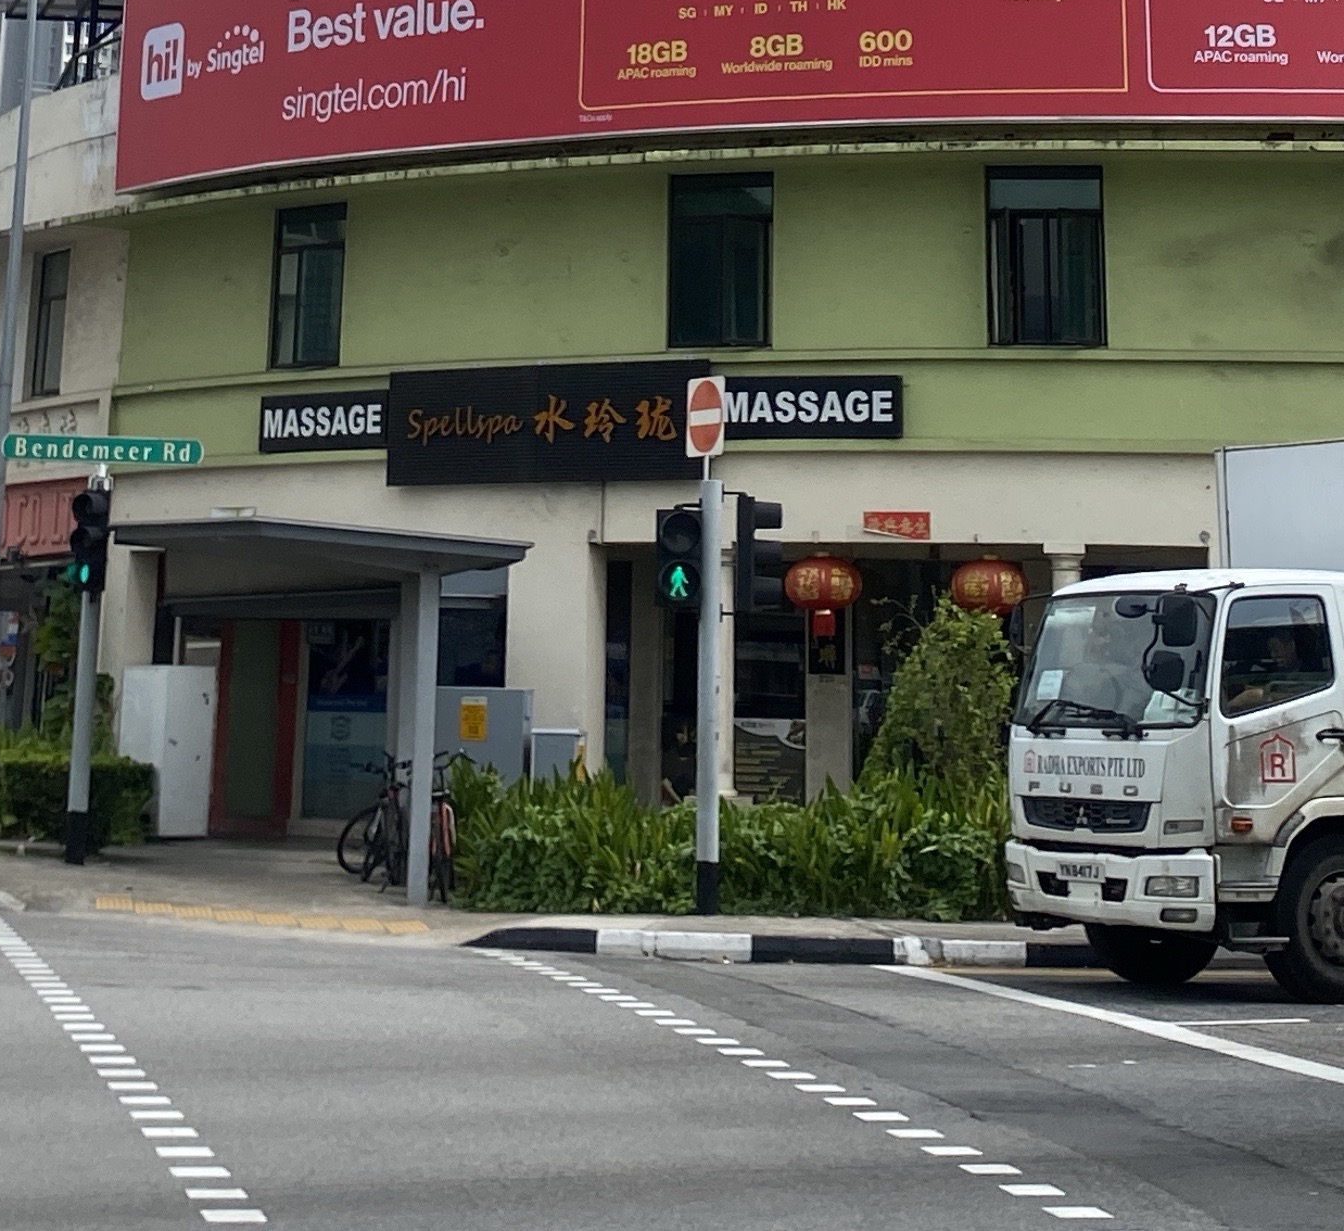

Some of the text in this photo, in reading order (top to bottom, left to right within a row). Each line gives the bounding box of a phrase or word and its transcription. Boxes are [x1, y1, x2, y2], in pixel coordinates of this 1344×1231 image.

[678, 7, 697, 20] SG
[714, 5, 734, 17] MY
[754, 2, 768, 15] ID
[789, 0, 808, 13] TH
[287, 3, 365, 53] Best
[1205, 24, 1277, 48] 12GB
[627, 40, 688, 65] 18GB
[750, 33, 804, 58] 8GB
[859, 29, 913, 53] 600
[186, 58, 203, 79] by
[205, 39, 265, 75] Singtel
[721, 58, 833, 75] Worldwide roaming
[859, 54, 913, 67] IDD mins
[1194, 50, 1289, 66] APAC roaming
[617, 65, 697, 80] APAC roaming
[282, 67, 467, 124] singtel.com/hi
[722, 390, 894, 424] MASSAGE
[263, 404, 382, 440] MASSAGE
[407, 405, 524, 447] Spellspa
[14, 437, 153, 461] Bendemeer
[163, 440, 192, 463] Rd
[1107, 757, 1125, 777] PTE
[1126, 758, 1146, 778] LTD
[1028, 781, 1139, 797] FUSO
